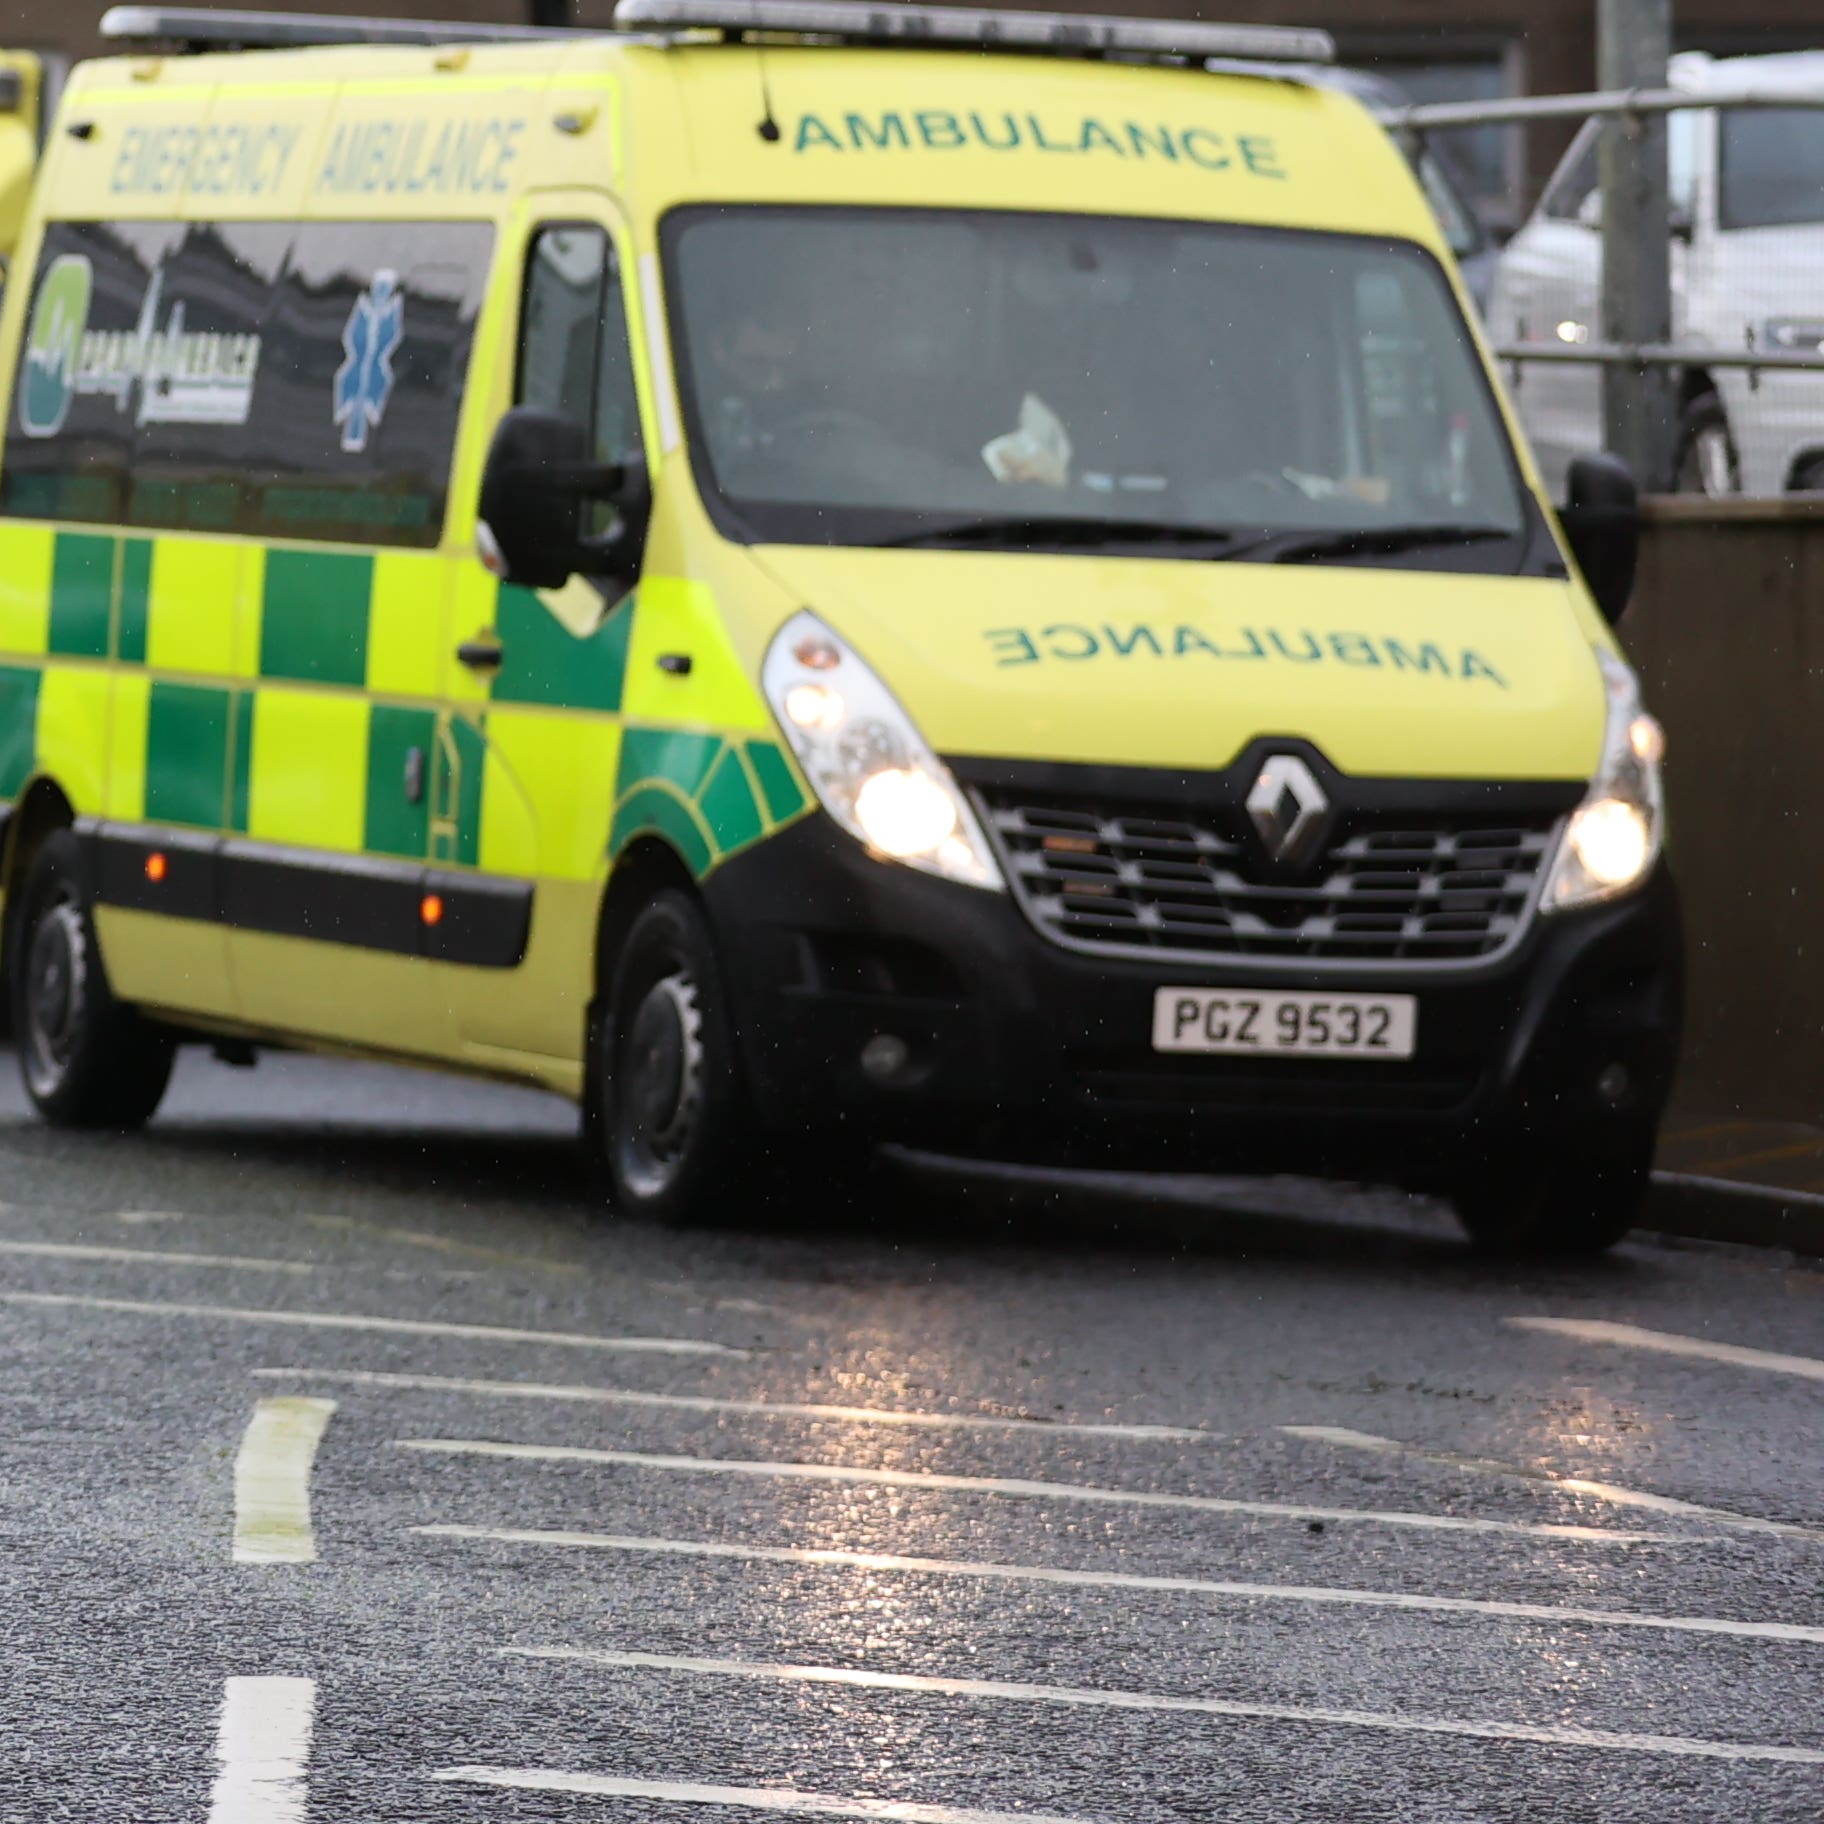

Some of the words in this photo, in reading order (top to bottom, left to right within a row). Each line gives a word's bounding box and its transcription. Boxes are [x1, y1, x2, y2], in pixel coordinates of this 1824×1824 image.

[109, 122, 303, 195] EMERGENCY
[315, 119, 527, 195] AMBULANCE
[793, 110, 1288, 180] AMBULANCE
[1174, 999, 1261, 1044] PGZ
[1275, 1002, 1391, 1048] 9532
